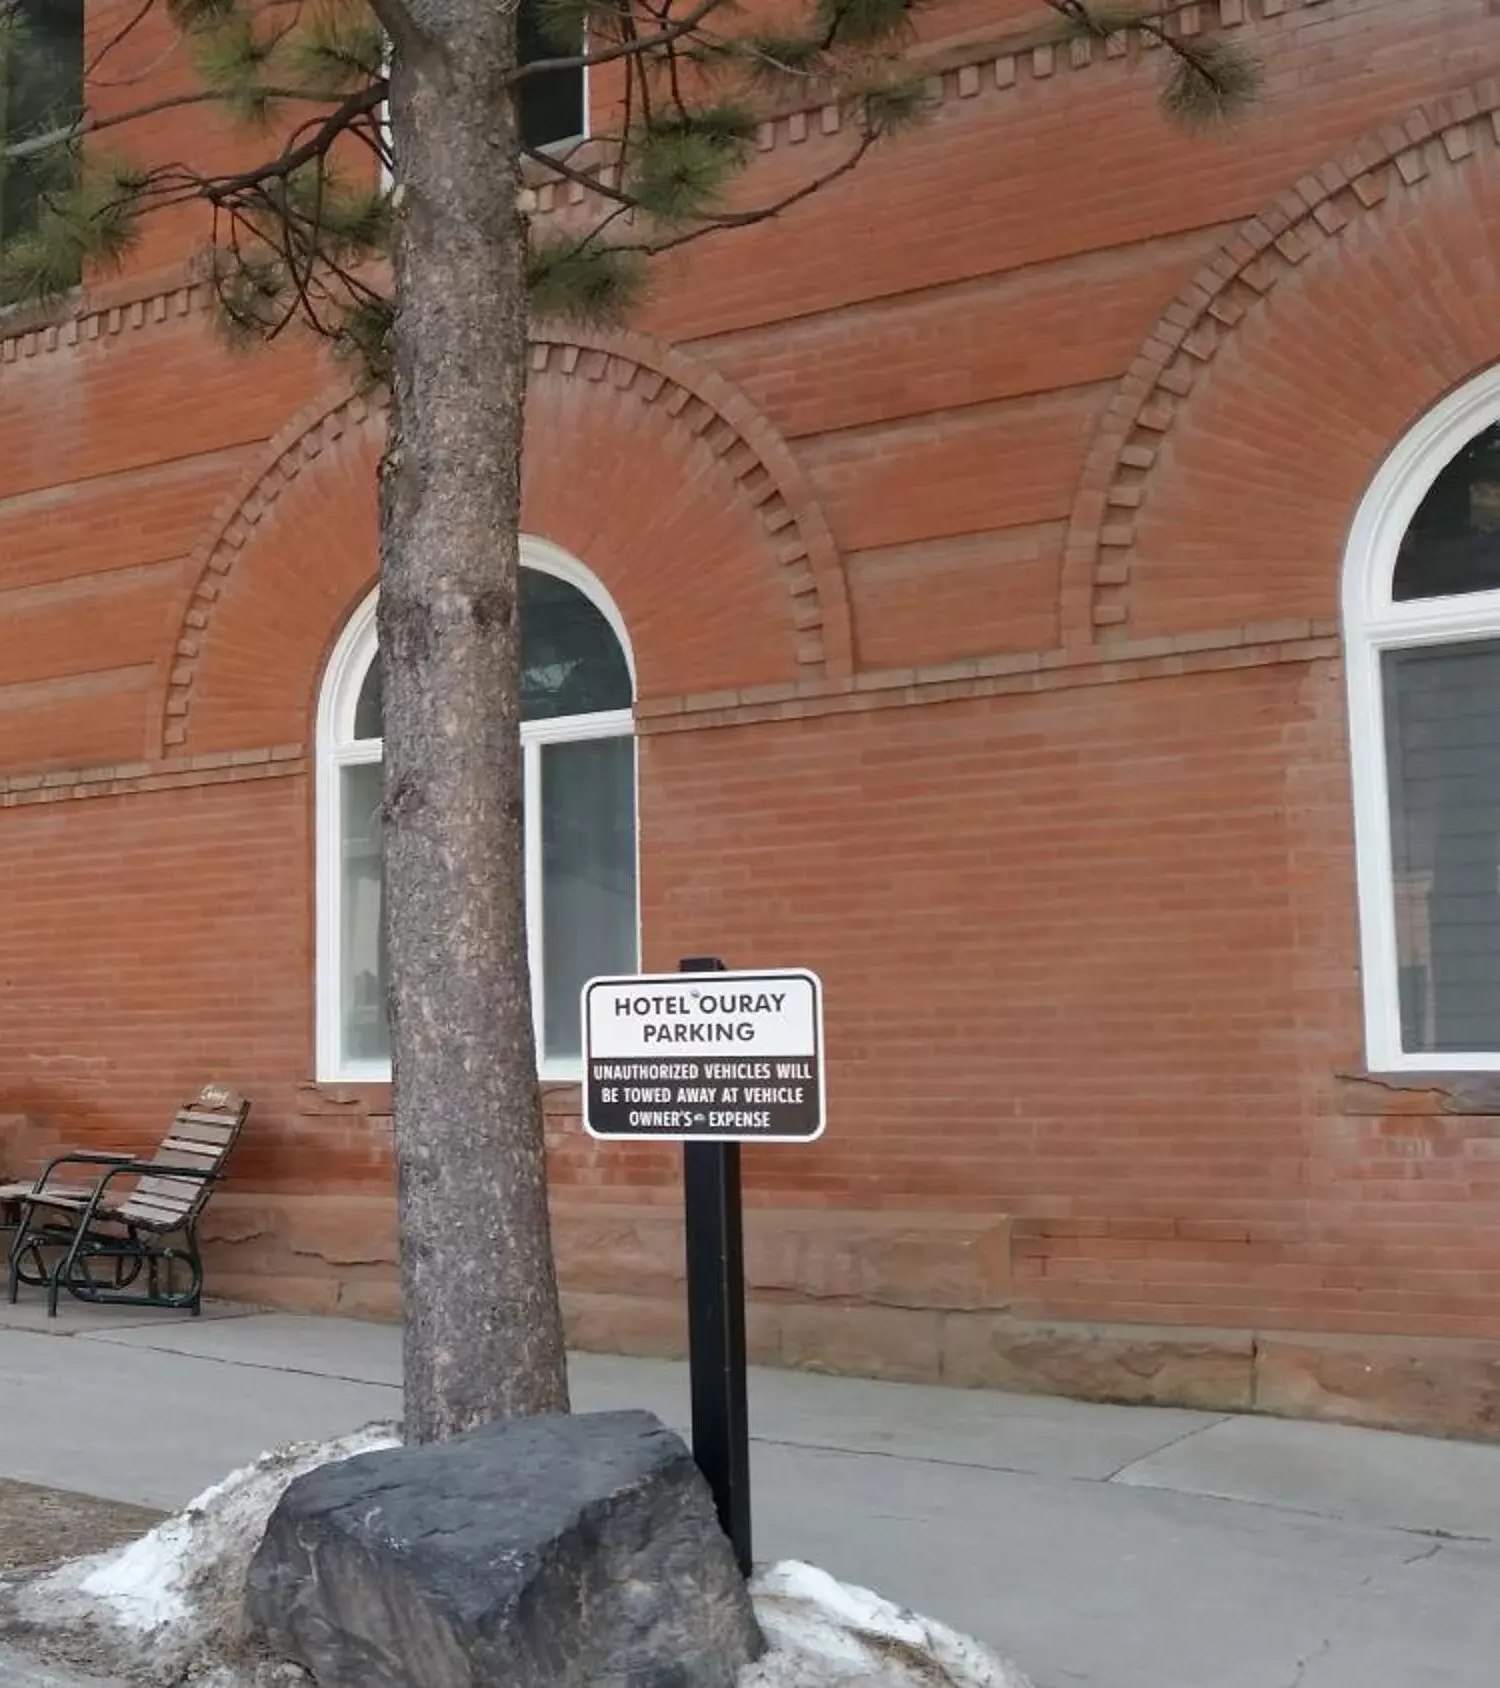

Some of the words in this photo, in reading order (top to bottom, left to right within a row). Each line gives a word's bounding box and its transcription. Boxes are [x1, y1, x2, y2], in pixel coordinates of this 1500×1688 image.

[614, 996, 690, 1016] HOTEL
[699, 993, 786, 1013] OURAY
[643, 1022, 755, 1043] PARKING
[593, 1064, 699, 1080] UNAUTHORIZED
[703, 1063, 771, 1080] VEHICLES
[776, 1063, 813, 1079] WILL
[601, 1087, 619, 1104] BE
[623, 1087, 672, 1104] TOWED
[676, 1087, 717, 1104] AWAY
[721, 1087, 739, 1104] AT
[743, 1087, 805, 1104] VEHICLE
[629, 1109, 693, 1128] OWNER'S
[709, 1110, 771, 1128] EXPENSE
